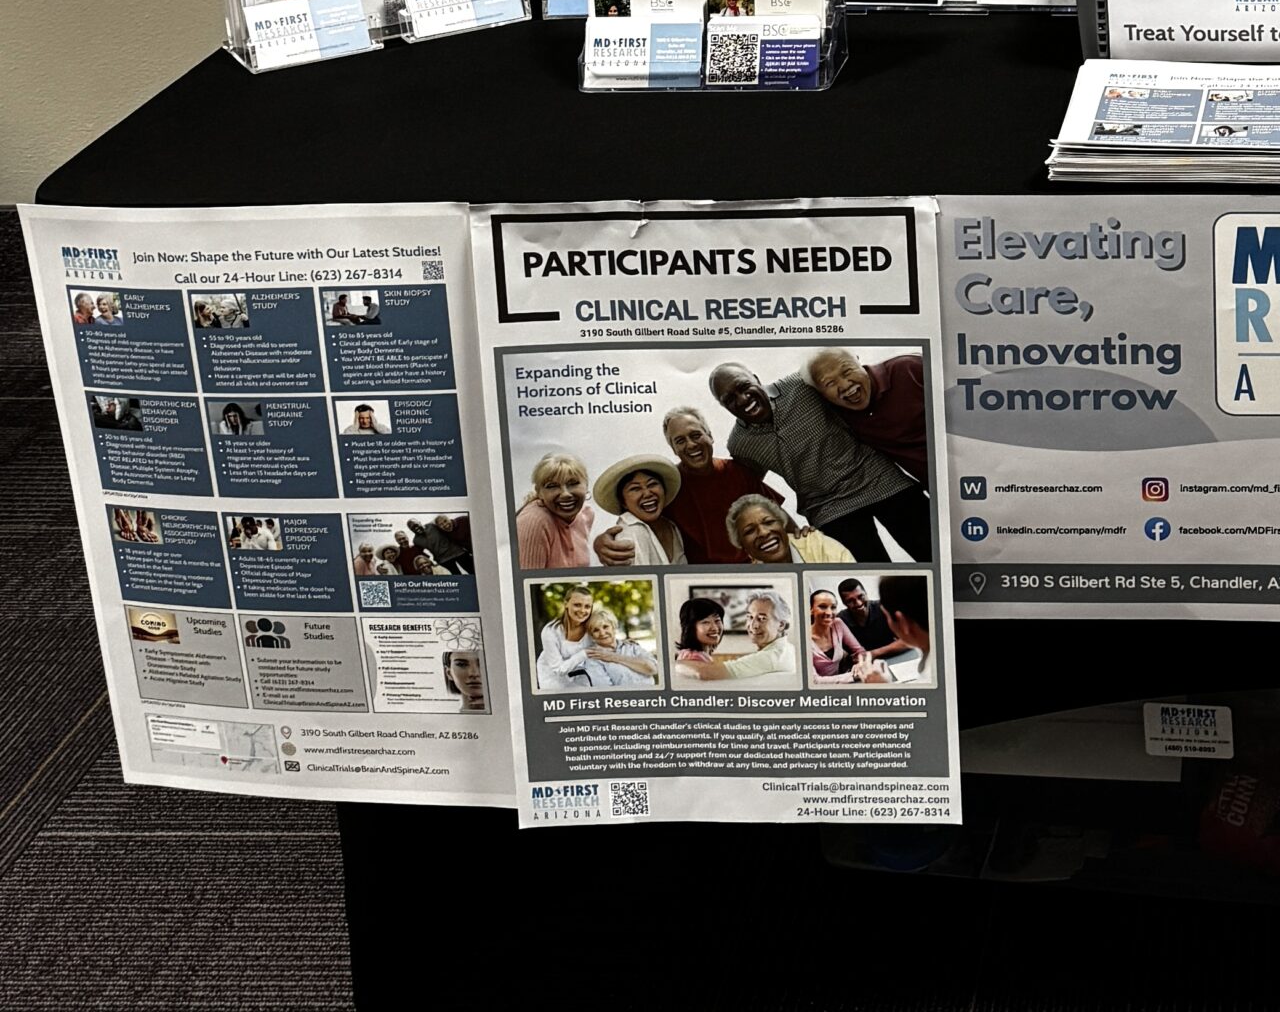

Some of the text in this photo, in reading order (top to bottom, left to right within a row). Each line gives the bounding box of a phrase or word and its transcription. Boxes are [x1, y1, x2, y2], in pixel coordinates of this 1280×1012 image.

[1124, 24, 1175, 41] Treat
[1180, 25, 1264, 42] Yourself
[953, 216, 1187, 273] Elevating
[133, 246, 441, 264] Join Now: Shape the Future with Our Latest Studies!
[523, 246, 892, 276] PARTICIPANTS NEEDED
[174, 268, 402, 284] Call our 24-Hour Line: (623) 267-8314
[955, 273, 1094, 322] Care,
[575, 297, 846, 321] CLINICAL RESEARCH
[956, 331, 1183, 376] Innovating
[516, 363, 620, 382] Expanding the
[517, 381, 657, 398] Horizons of Clinical
[955, 378, 1178, 412] Tomorrow
[519, 401, 652, 417] Research Inclusion
[995, 484, 1102, 492] mdfirstresearchaz.com
[997, 526, 1127, 535] linkedin.com/company/mdfr
[1001, 575, 1039, 587] 3190
[1044, 576, 1054, 588] S
[1059, 576, 1111, 588] Gilbert
[1115, 576, 1135, 588] Rd
[1140, 576, 1166, 588] Ste
[1171, 576, 1184, 590] 5,
[1189, 576, 1262, 590] Chandler,
[543, 696, 925, 711] MD First Research Chandler: Discover Medical Innovation
[304, 747, 416, 755] www.mdfirstresearchaz.com
[307, 764, 450, 775] ClinicalTrials@BrainAndSpineAZ.com
[762, 782, 949, 793] ClinicalTrials@brainandspineaz.com
[803, 795, 950, 804] www.mdfirstresearchaz.com
